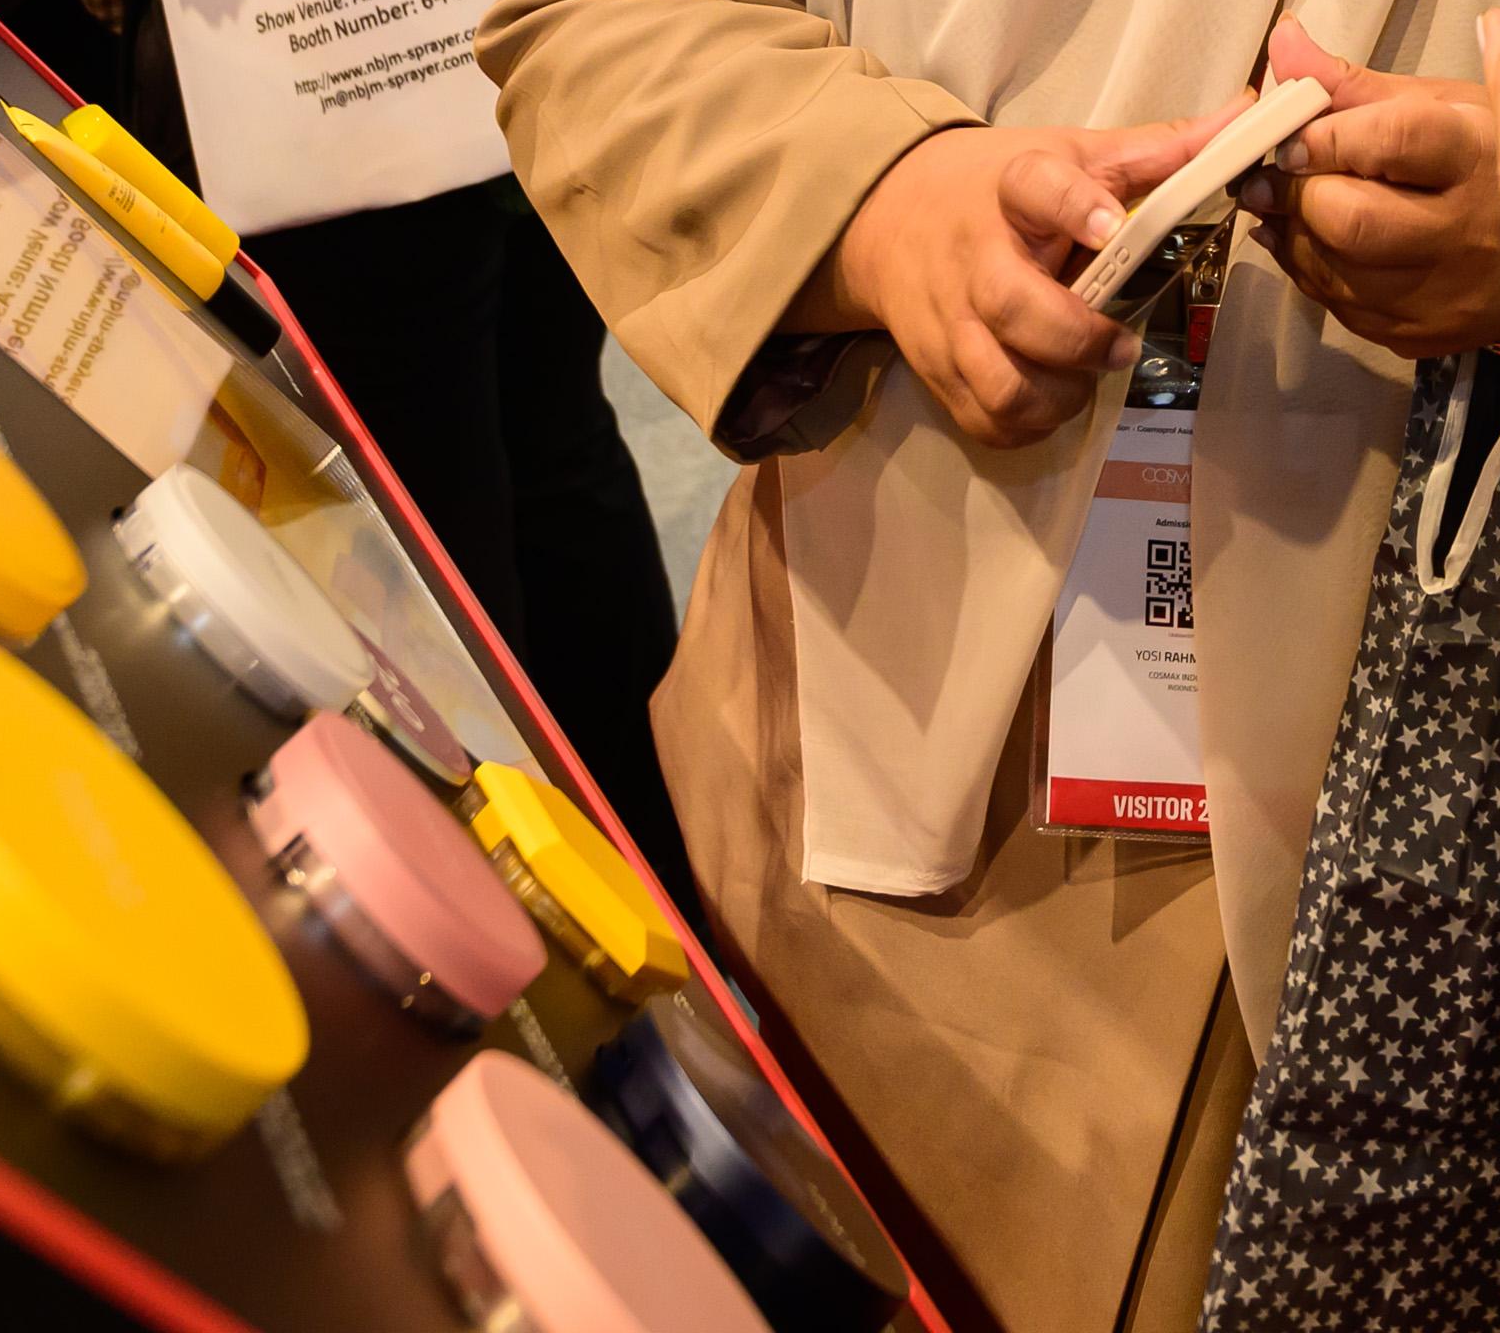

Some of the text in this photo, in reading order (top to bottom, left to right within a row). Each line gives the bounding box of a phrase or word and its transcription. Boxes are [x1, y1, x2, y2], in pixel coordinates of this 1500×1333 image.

[255, 8, 296, 34] Show
[288, 25, 334, 54] Booth
[334, 0, 419, 40] Number:
[319, 51, 475, 115] jm@nbjm-sprayer.com
[1141, 467, 1191, 484] COSM
[1155, 518, 1192, 529] Admissi
[1135, 649, 1161, 662] YOSI
[1148, 671, 1180, 681] COSMAX
[1167, 684, 1199, 693] INDONES
[1113, 794, 1194, 822] VISITOR
